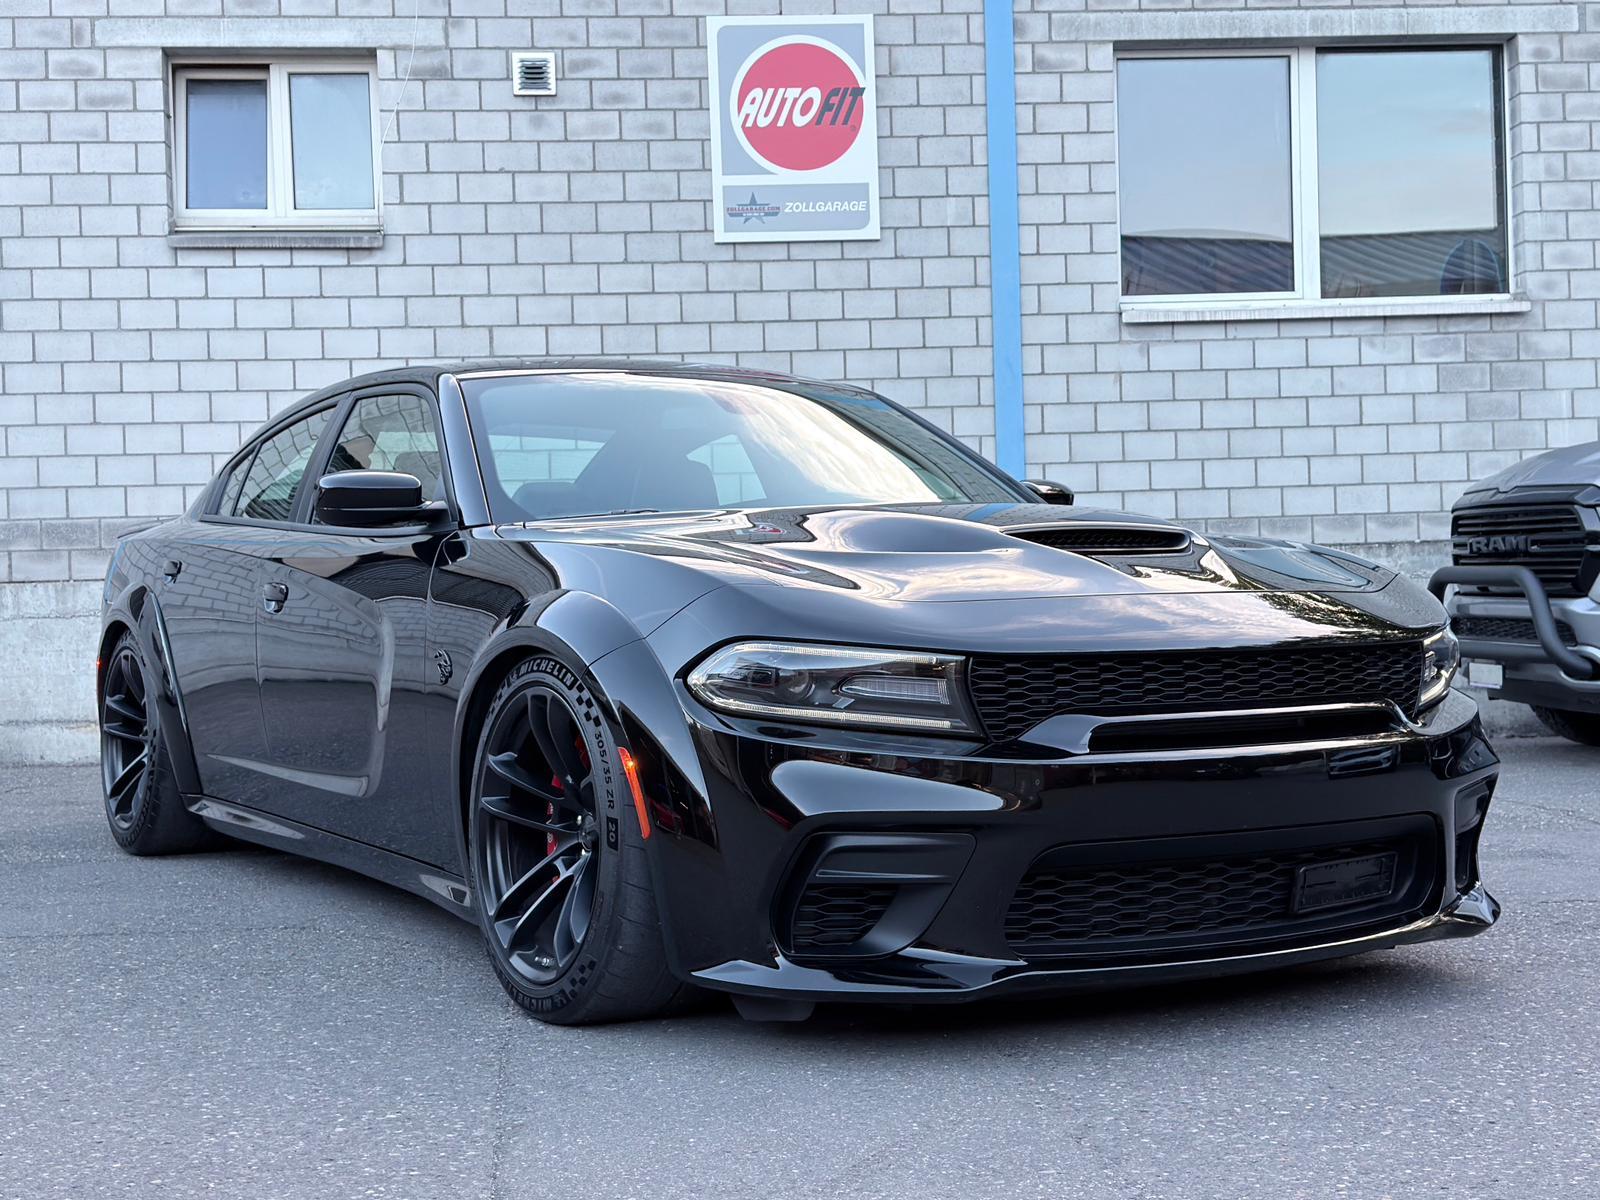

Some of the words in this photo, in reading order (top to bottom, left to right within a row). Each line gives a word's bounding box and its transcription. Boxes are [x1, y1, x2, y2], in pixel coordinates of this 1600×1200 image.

[739, 86, 866, 128] AUTOFIT
[784, 201, 868, 213] ZOLLGARAGE
[1471, 536, 1526, 552] RAM
[519, 658, 575, 685] MICHELIN
[594, 731, 613, 785] 305/35
[606, 789, 615, 811] ZR
[608, 822, 617, 843] 20
